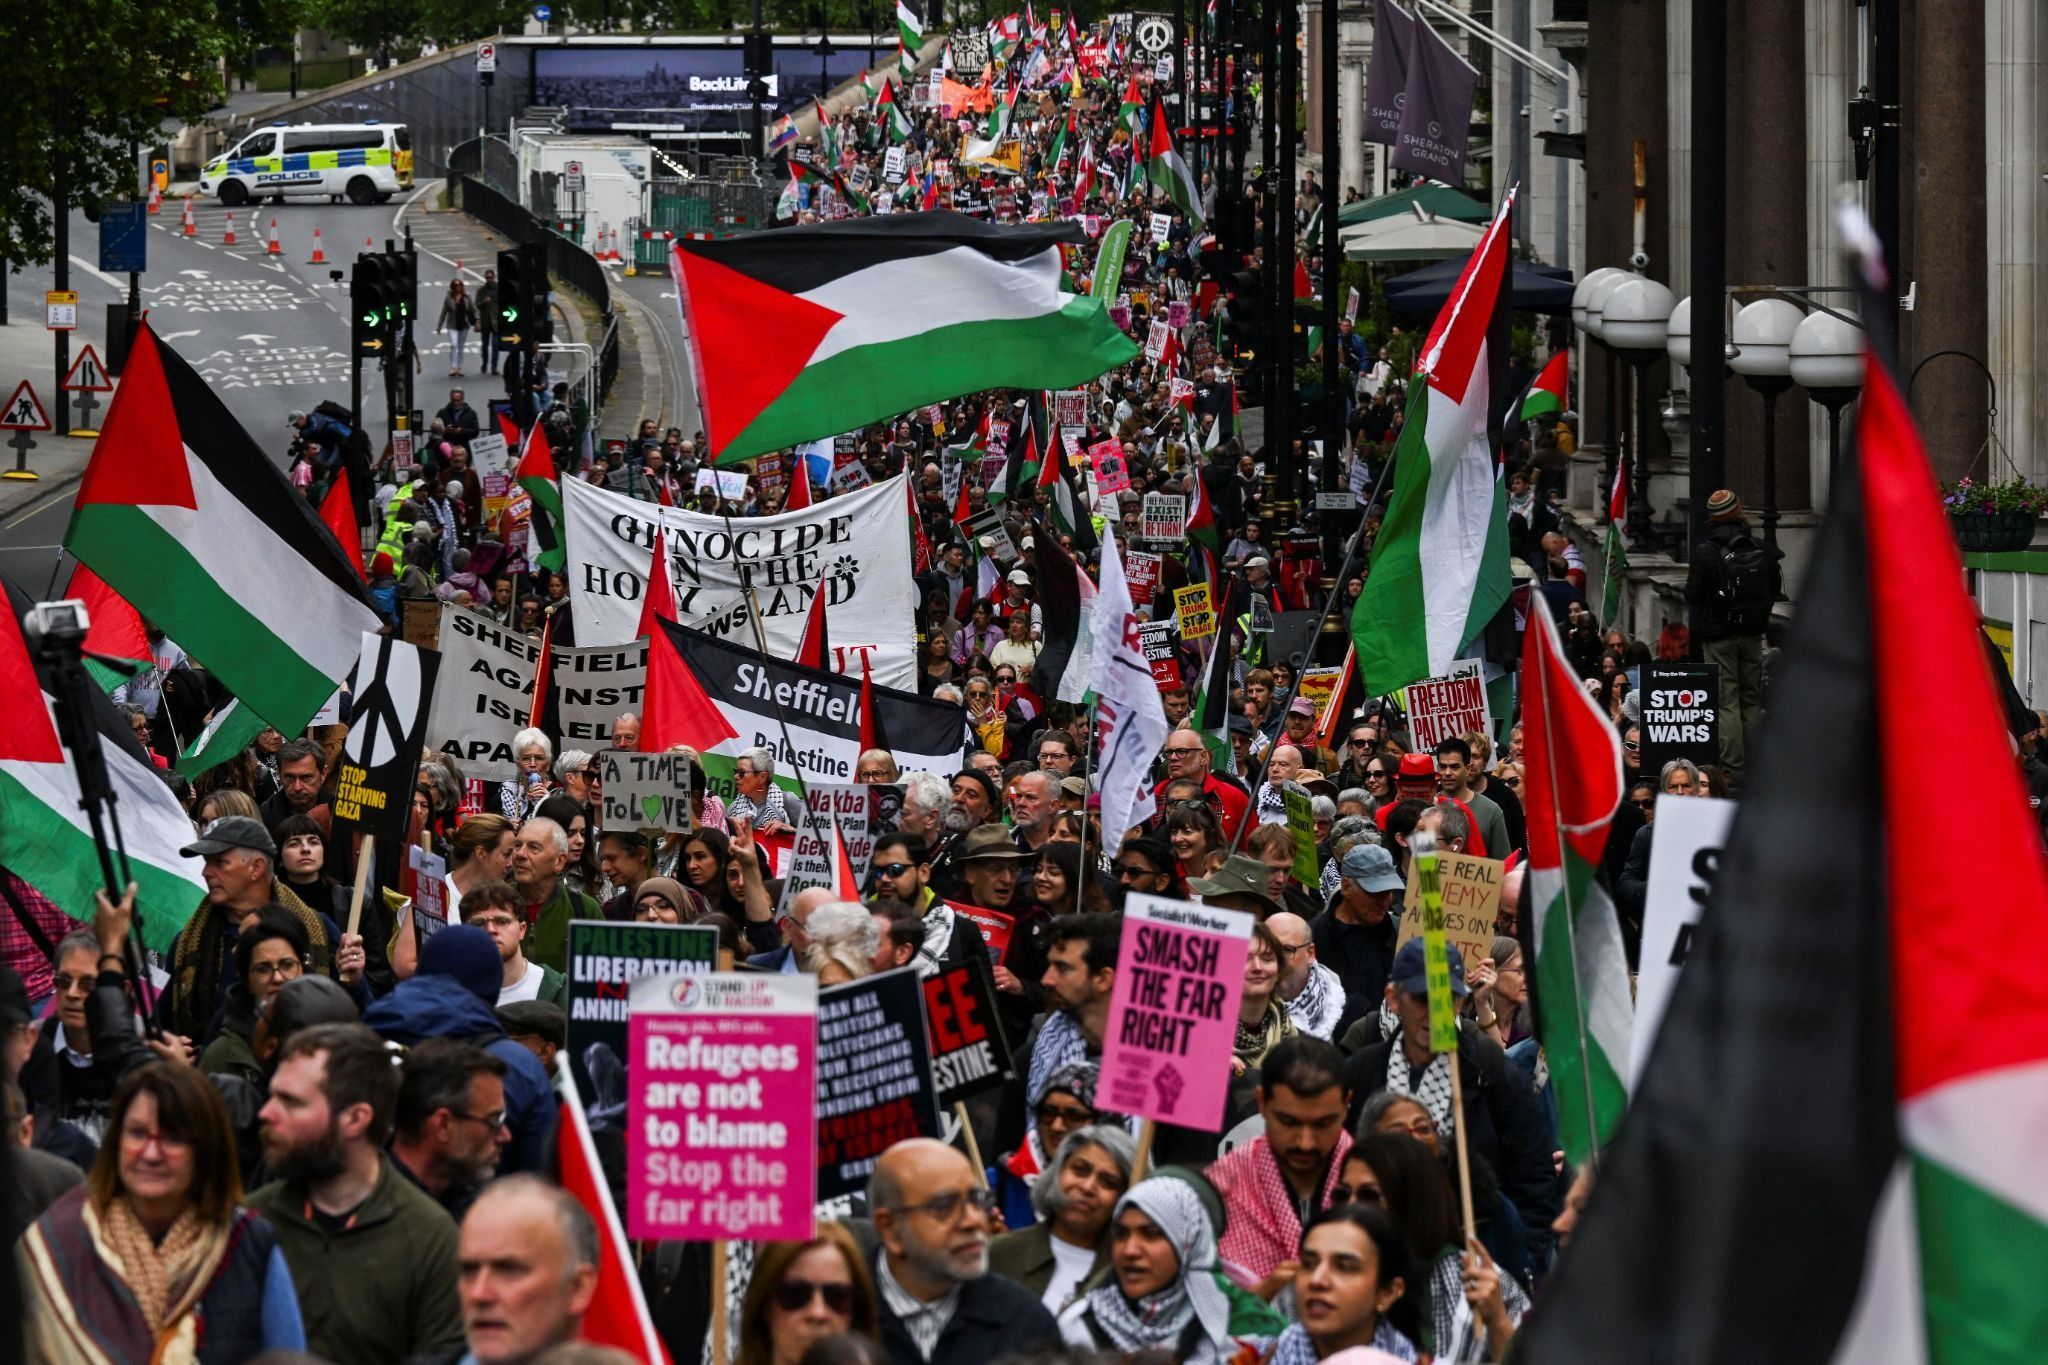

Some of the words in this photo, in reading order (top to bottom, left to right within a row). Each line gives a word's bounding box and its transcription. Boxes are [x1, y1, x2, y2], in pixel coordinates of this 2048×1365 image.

[1371, 107, 1401, 121] SHER
[1404, 134, 1459, 159] SHERATON
[1411, 149, 1449, 166] GRAND
[257, 171, 321, 182] POLICE
[840, 469, 862, 487] Stop
[1146, 506, 1183, 515] EXIST!
[1146, 514, 1183, 522] RESIST!
[1146, 521, 1182, 537] RETURN!
[732, 551, 821, 589] THE
[1139, 559, 1149, 567] NOT
[582, 562, 702, 614] HOY
[1178, 590, 1207, 607] STOP
[1180, 602, 1209, 616] TRUMP
[1182, 612, 1210, 629] STOP
[1142, 631, 1168, 644] EEDOM
[1184, 623, 1212, 637] FARAGE
[1147, 646, 1173, 661] ESTINE
[1408, 677, 1483, 718] FREEDOM
[1650, 689, 1708, 708] STOP
[476, 693, 612, 742] ISREL
[1431, 706, 1448, 714] FOR
[1643, 709, 1715, 723] TRUMP'S
[1413, 708, 1485, 749] PALESTINE
[1647, 724, 1710, 742] WARS
[755, 731, 849, 777] Palestine
[341, 764, 367, 785] STOP
[630, 755, 687, 790] TIME
[338, 782, 388, 810] STARVING
[809, 789, 865, 815] Nakba
[335, 799, 361, 822] GAZA
[843, 817, 866, 831] Plan
[797, 835, 872, 859] Genide
[793, 859, 803, 873] is
[1454, 861, 1496, 885] REAL
[1468, 916, 1488, 936] ON
[575, 927, 712, 959] PALESTINE
[1134, 926, 1221, 977] SMASH
[574, 955, 712, 983] LIBERATION
[705, 980, 746, 993] STAND
[751, 980, 769, 992] UP
[1130, 966, 1171, 1010] THE
[1175, 976, 1227, 1021] FAR
[706, 994, 721, 1007] TO
[818, 1022, 905, 1061] OLITICIANS
[1119, 1008, 1196, 1056] RIGHT
[645, 1035, 800, 1079] Refugees
[933, 1040, 998, 1093] ESTINE
[645, 1082, 701, 1110] are
[706, 1076, 764, 1110] not
[817, 1089, 876, 1119] UNDING
[644, 1114, 681, 1148] to
[685, 1112, 788, 1149] blame
[645, 1152, 723, 1192] Stop
[730, 1153, 788, 1188] the
[645, 1190, 695, 1226] far
[701, 1191, 784, 1233] right
